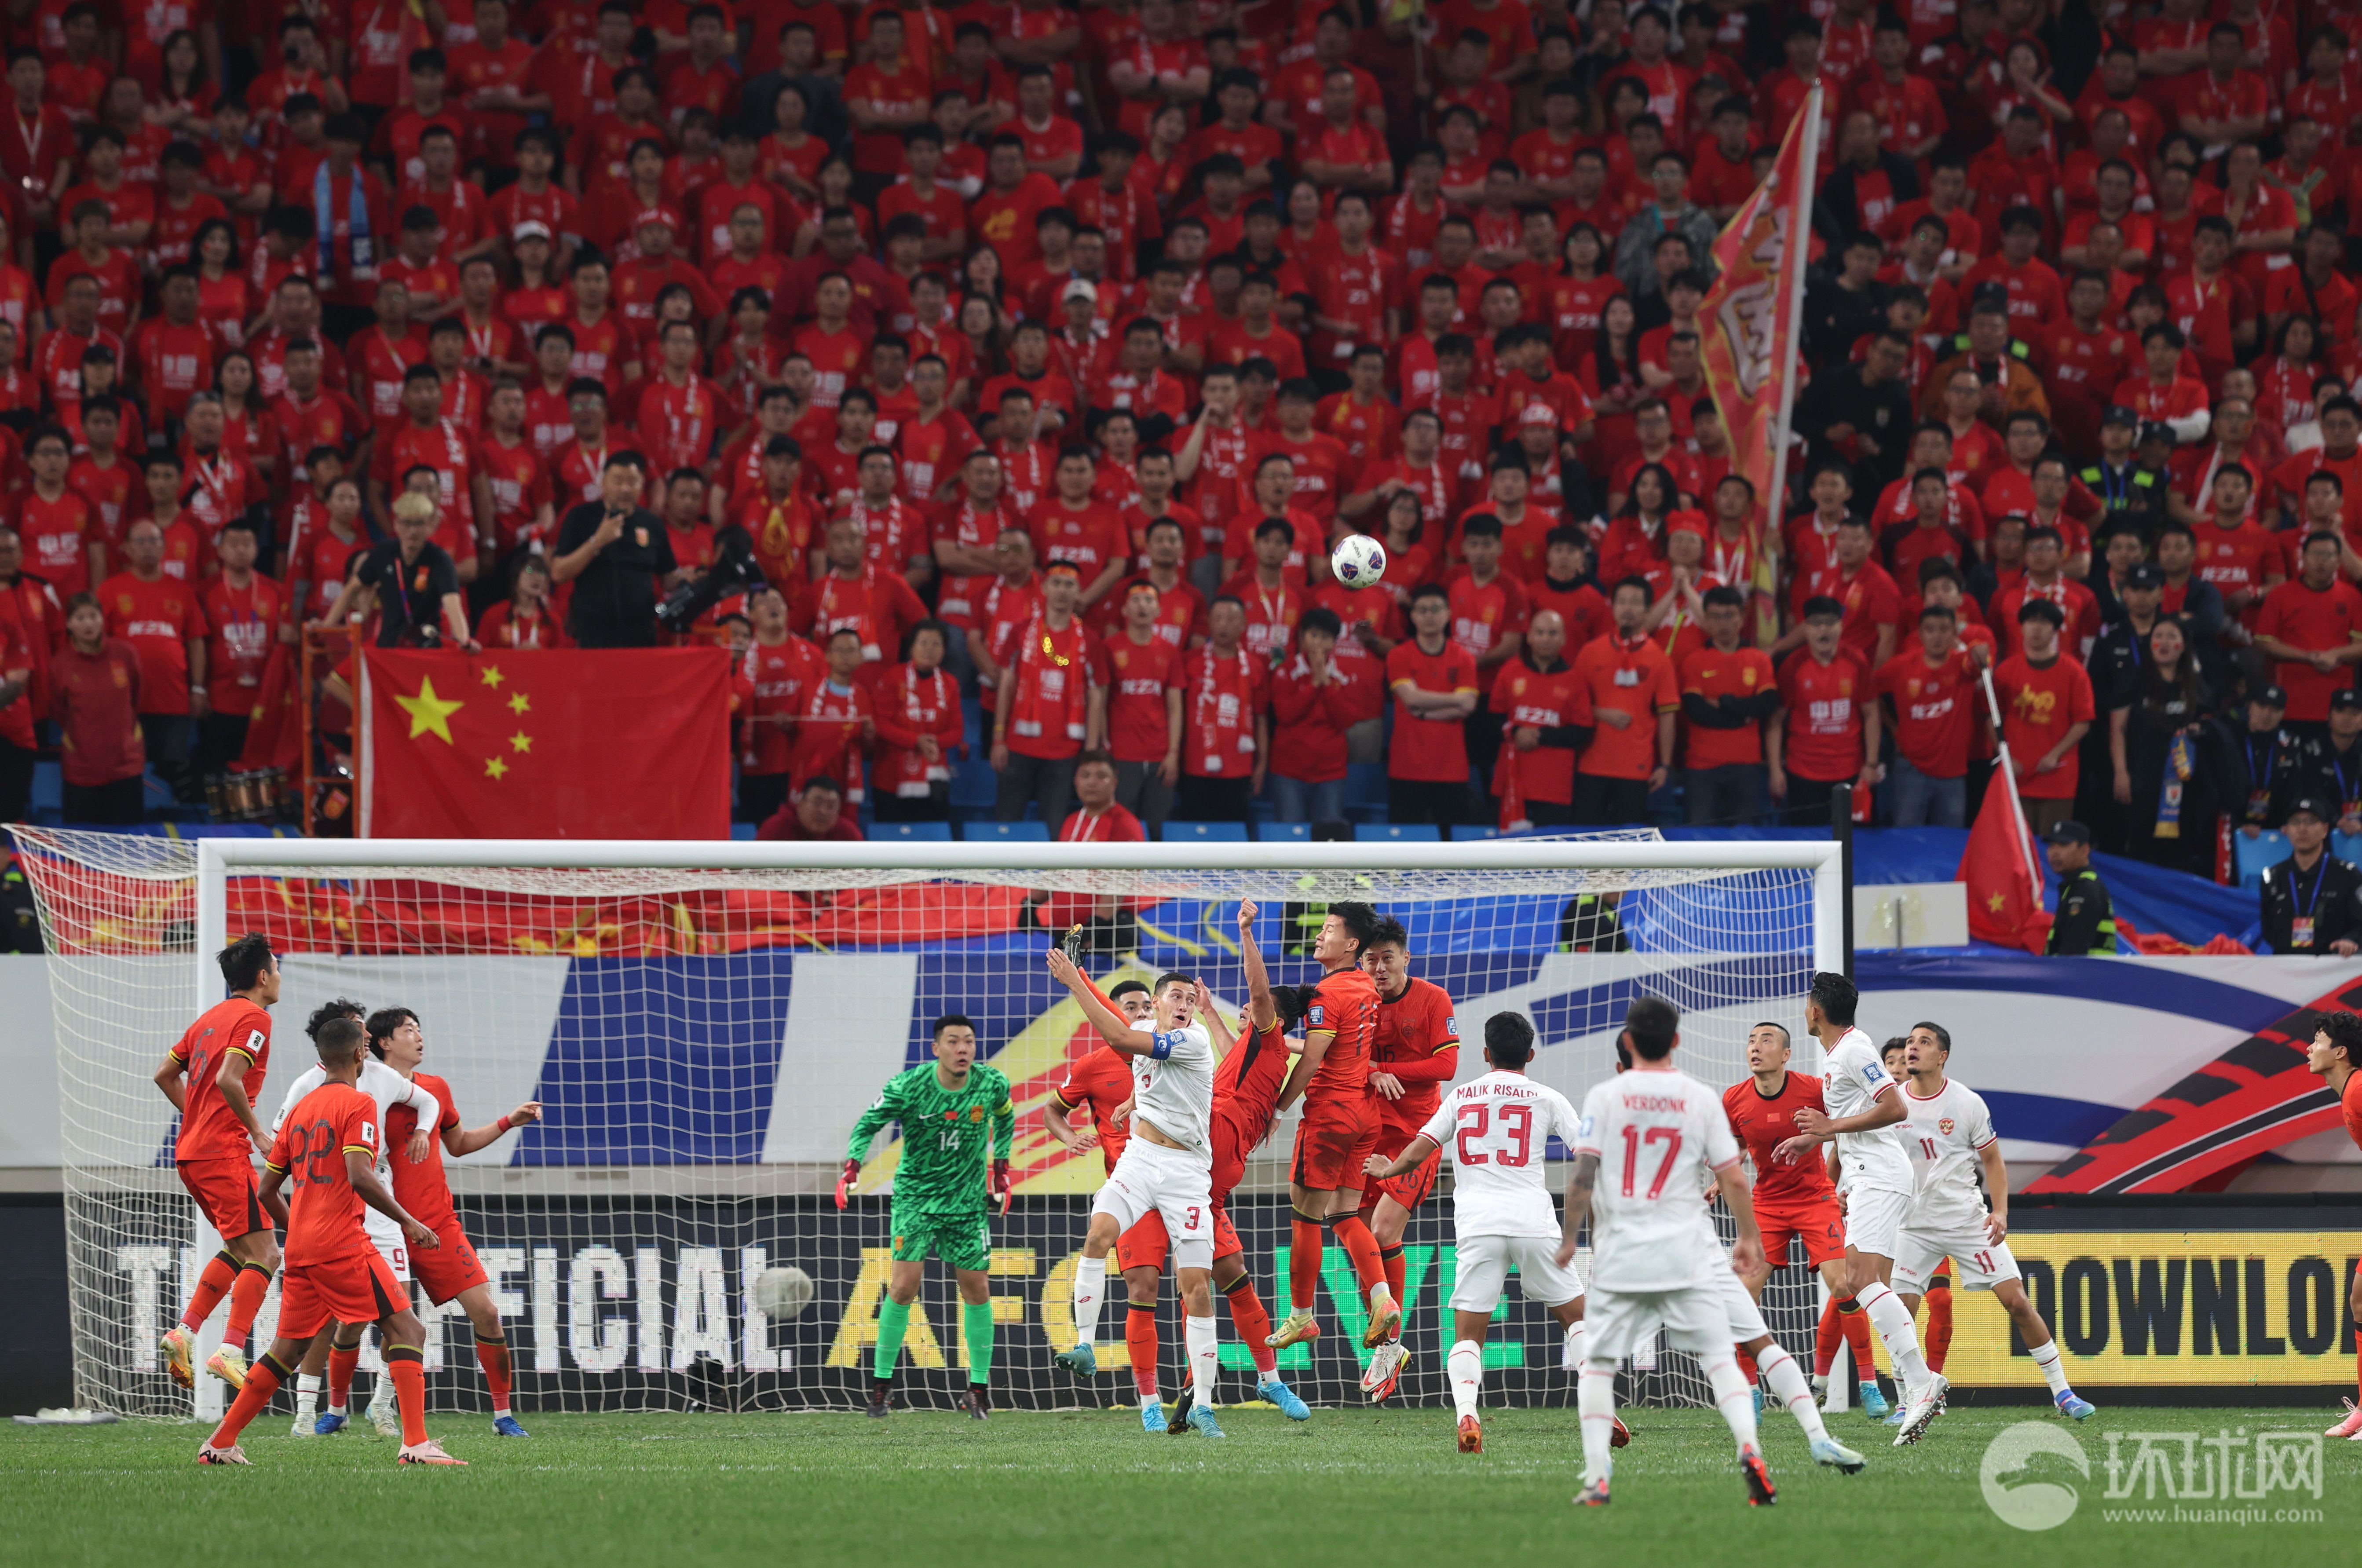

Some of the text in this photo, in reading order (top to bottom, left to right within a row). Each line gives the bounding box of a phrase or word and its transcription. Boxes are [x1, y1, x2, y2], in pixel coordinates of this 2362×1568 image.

[188, 1027, 215, 1087] 6
[1457, 1084, 1538, 1100] MALIK RISALDI
[1623, 1094, 1687, 1114] VERDONK
[939, 1129, 960, 1151] 14
[1456, 1103, 1532, 1167] 23
[290, 1119, 336, 1188] 22
[1919, 1137, 1938, 1160] 11
[1620, 1124, 1682, 1199] 17
[1115, 1179, 1130, 1194] erspo
[1184, 1206, 1200, 1231] 3
[1827, 1221, 1841, 1242] 4
[393, 1248, 405, 1272] 9
[456, 1245, 473, 1267] 3
[1974, 1250, 1996, 1274] 11
